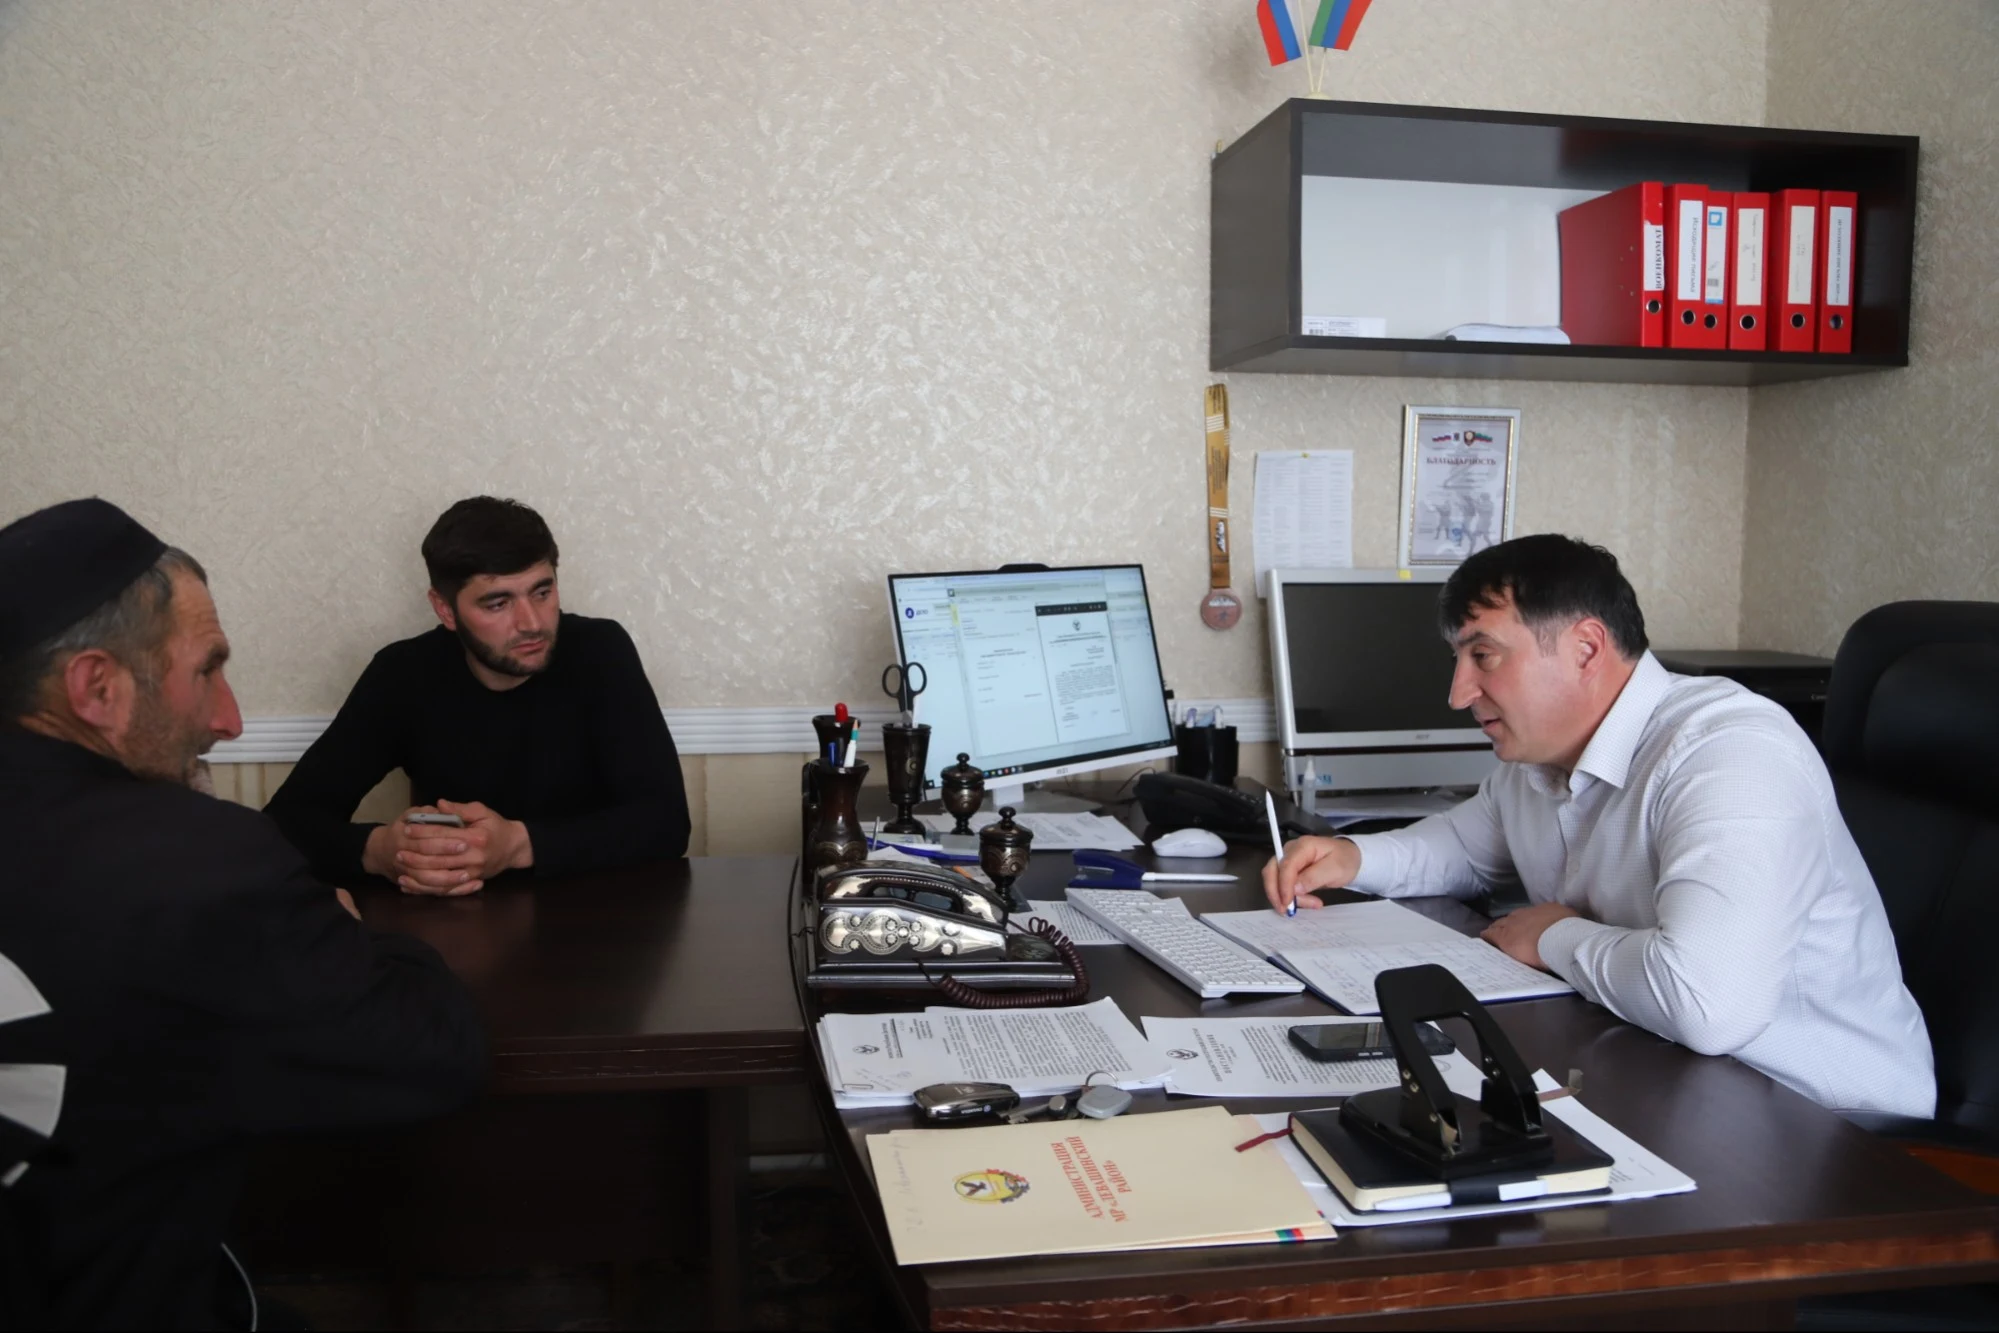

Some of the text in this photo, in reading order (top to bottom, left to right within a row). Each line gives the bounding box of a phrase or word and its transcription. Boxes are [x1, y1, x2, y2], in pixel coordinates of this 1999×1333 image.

[1655, 228, 1663, 290] ВОЕНКОМАТ
[1050, 1142, 1104, 1219] АДМИНИСТРАЦИЯ
[1102, 1160, 1132, 1193] РАЙОН»
[1109, 1209, 1127, 1222] МР
